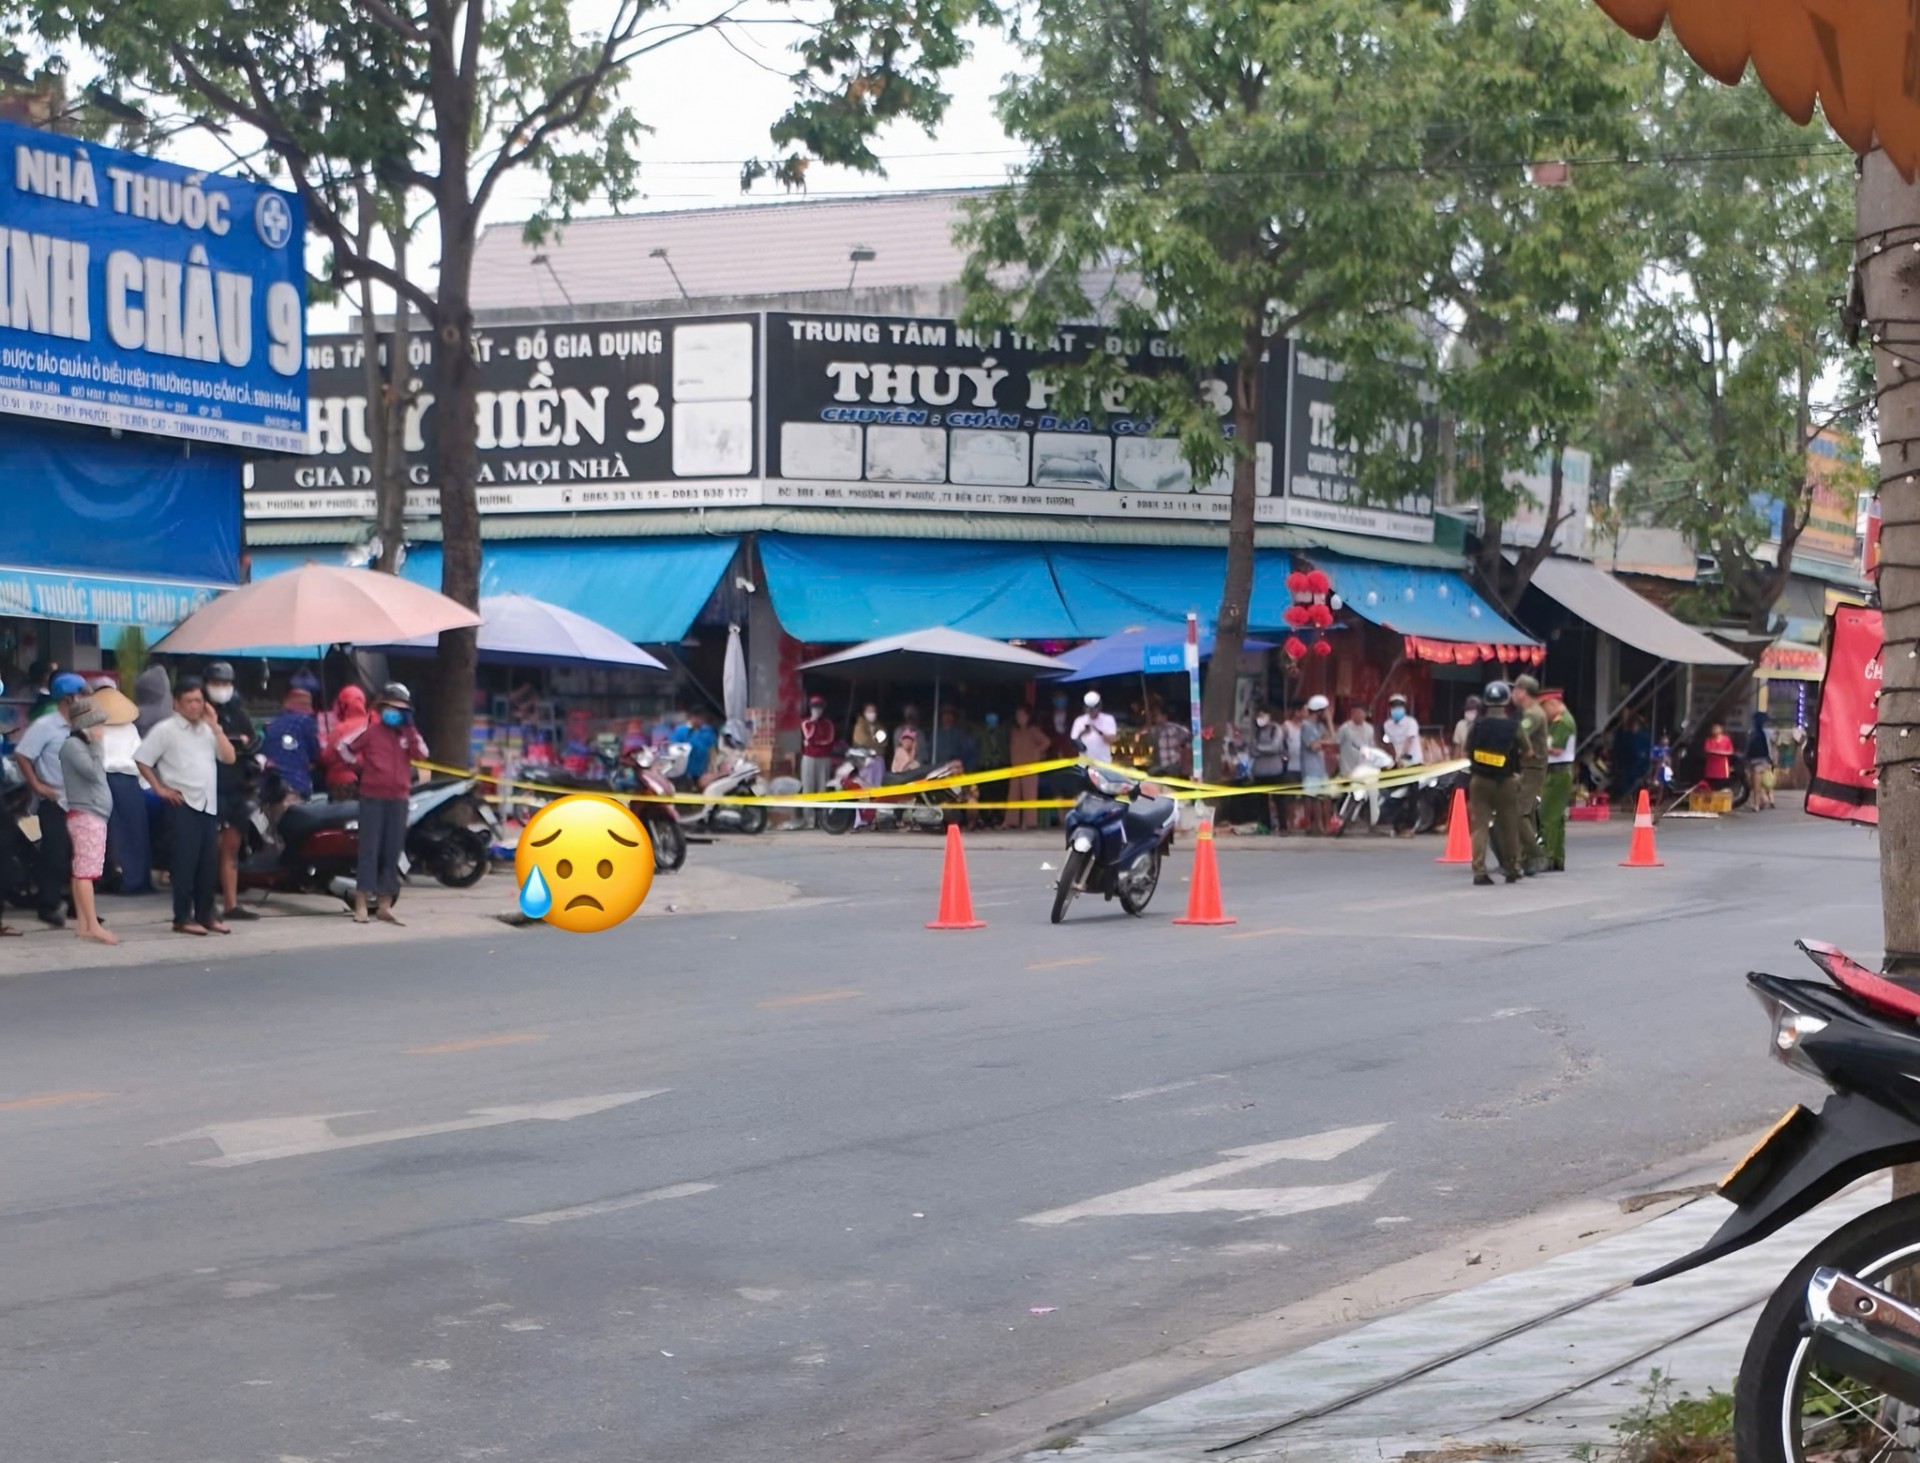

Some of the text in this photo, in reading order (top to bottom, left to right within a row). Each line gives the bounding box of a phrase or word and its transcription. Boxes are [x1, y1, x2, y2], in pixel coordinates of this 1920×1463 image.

[16, 145, 231, 236] NHÀ THUỐC
[107, 244, 252, 368] CHÂU
[266, 281, 302, 377] 9
[554, 333, 594, 358] GIA
[600, 329, 662, 361] DỤNG
[788, 320, 880, 344] TRUNG
[889, 321, 946, 347] TÂM
[626, 382, 665, 444] 3
[820, 406, 928, 426] CHUYÊN
[295, 465, 345, 488] GIA
[503, 460, 560, 485] MỌI
[568, 452, 630, 480] NHÀ
